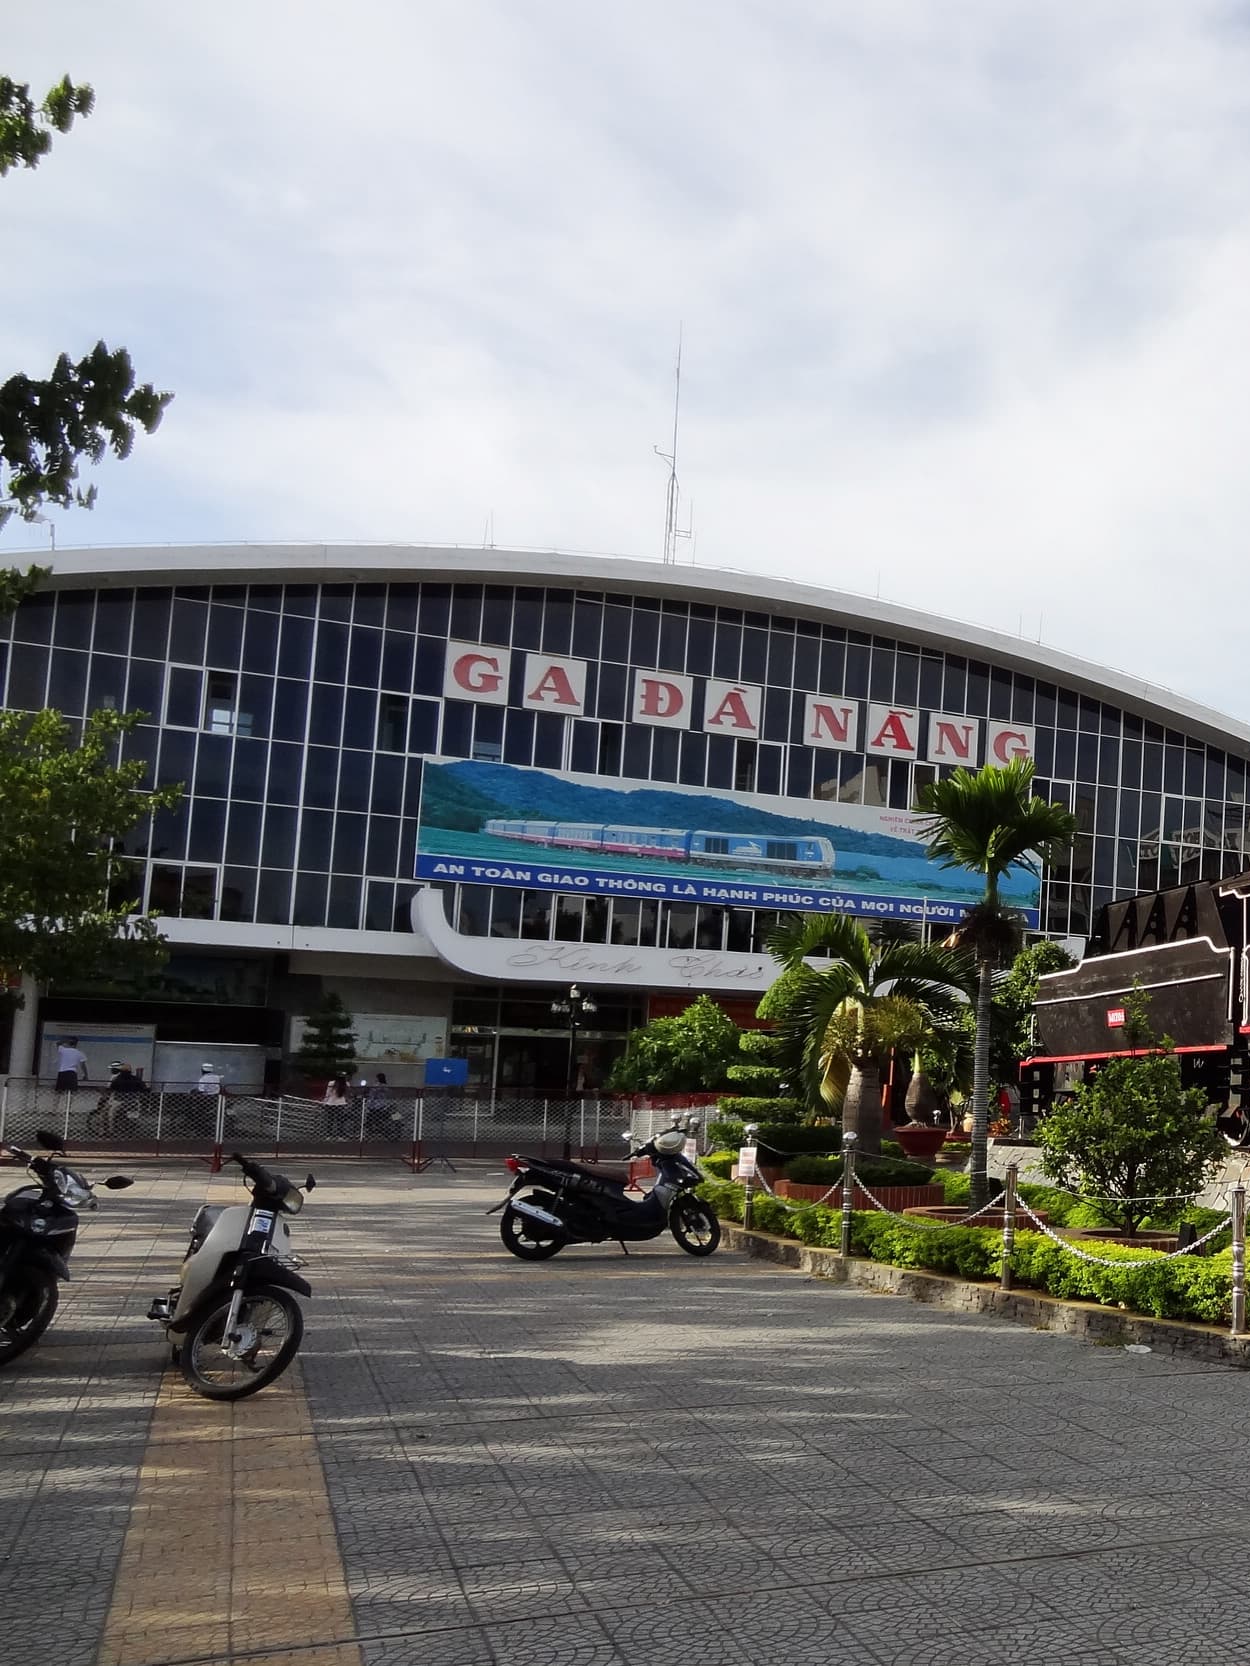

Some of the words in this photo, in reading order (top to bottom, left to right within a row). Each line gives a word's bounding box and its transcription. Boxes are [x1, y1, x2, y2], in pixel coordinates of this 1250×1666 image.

[453, 653, 580, 706] GA
[640, 678, 756, 730] ĐÀ
[433, 863, 465, 875] AN
[471, 867, 531, 881] TOÀN
[537, 872, 589, 886] GIAO
[595, 877, 666, 893] THÔNG
[672, 884, 697, 895] LÀ
[703, 887, 757, 900] HẠNH
[763, 892, 814, 905] PHÚC
[818, 896, 857, 908] CỦA
[861, 900, 894, 912] MỌI
[899, 904, 955, 917] NGƯỜI
